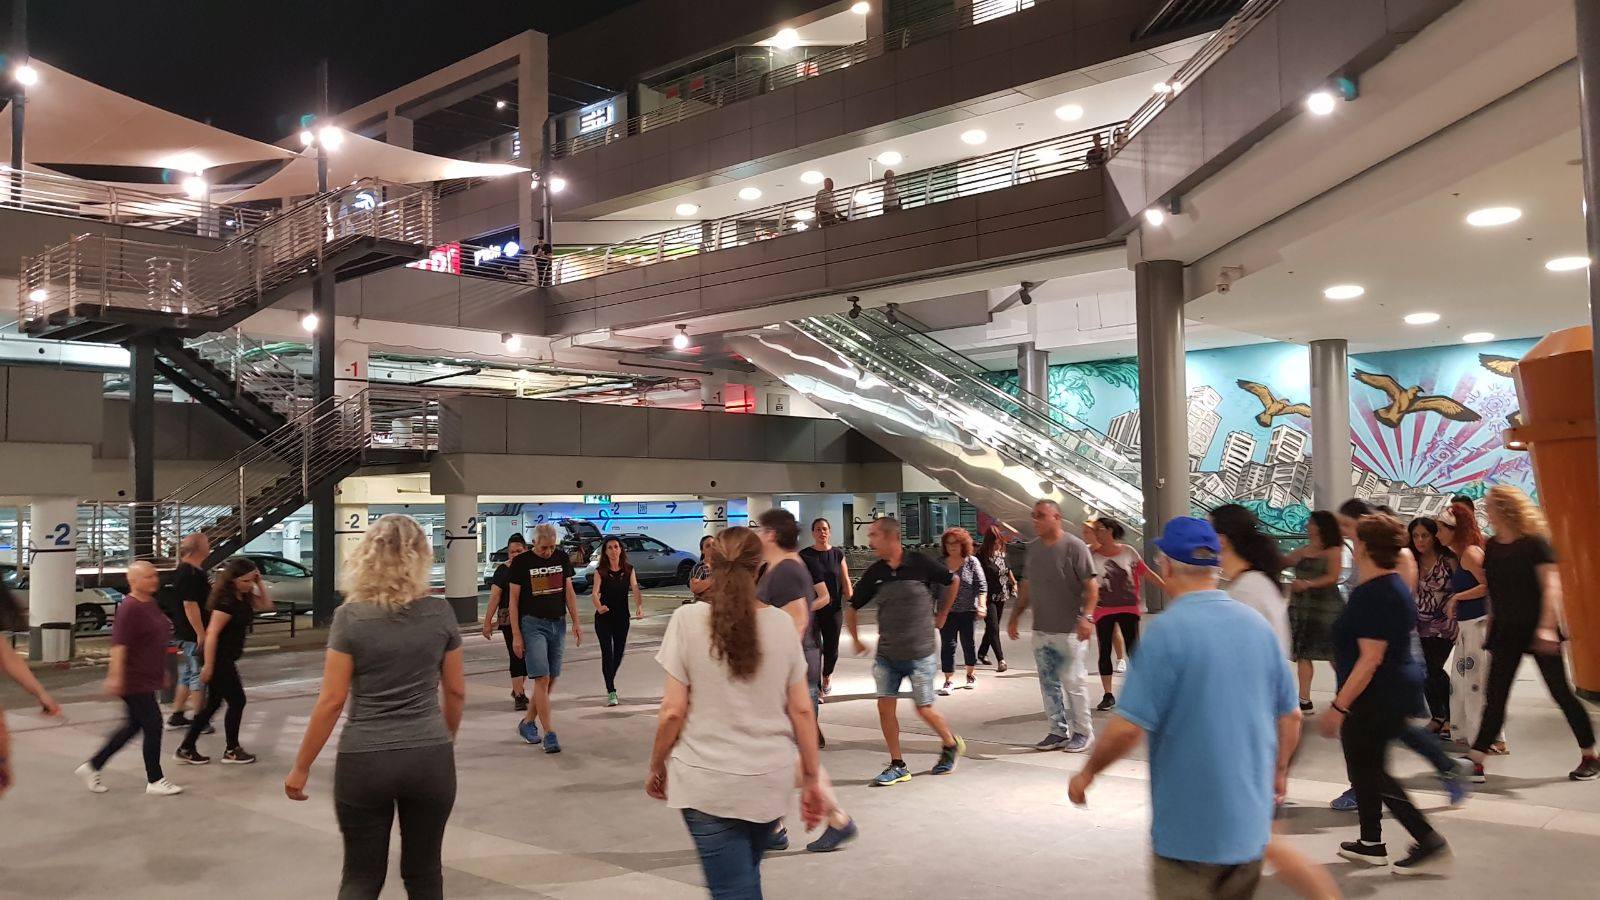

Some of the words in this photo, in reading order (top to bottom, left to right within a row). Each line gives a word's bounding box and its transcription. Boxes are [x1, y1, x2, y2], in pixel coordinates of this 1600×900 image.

[345, 361, 358, 377] -1
[611, 502, 620, 514] -2
[714, 506, 724, 518] -2
[344, 514, 360, 528] -2
[461, 517, 477, 534] -2
[45, 523, 71, 545] -2
[530, 565, 563, 575] BOSS
